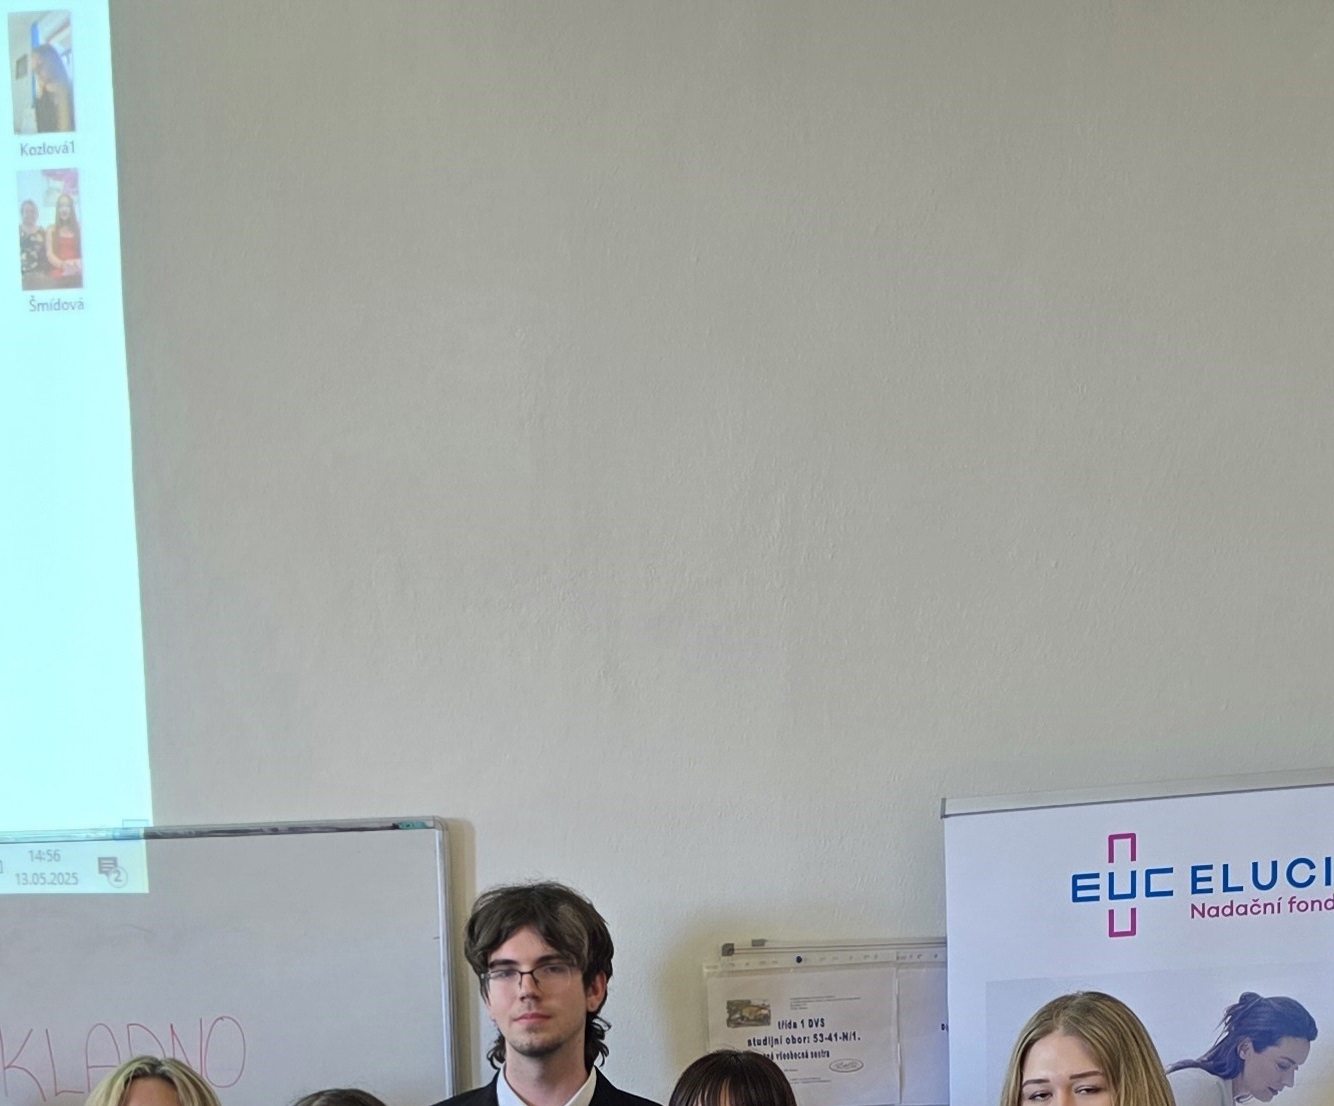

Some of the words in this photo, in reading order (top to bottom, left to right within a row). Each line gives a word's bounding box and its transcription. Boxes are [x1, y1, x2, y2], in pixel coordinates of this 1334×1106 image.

[19, 141, 75, 157] Kozlová1
[28, 849, 61, 863] 14:56
[15, 872, 79, 886] 13.05.2025
[1071, 867, 1174, 903] EUC
[1190, 896, 1282, 919] Nadační
[808, 1018, 825, 1028] DVS
[786, 1035, 810, 1045] obor:
